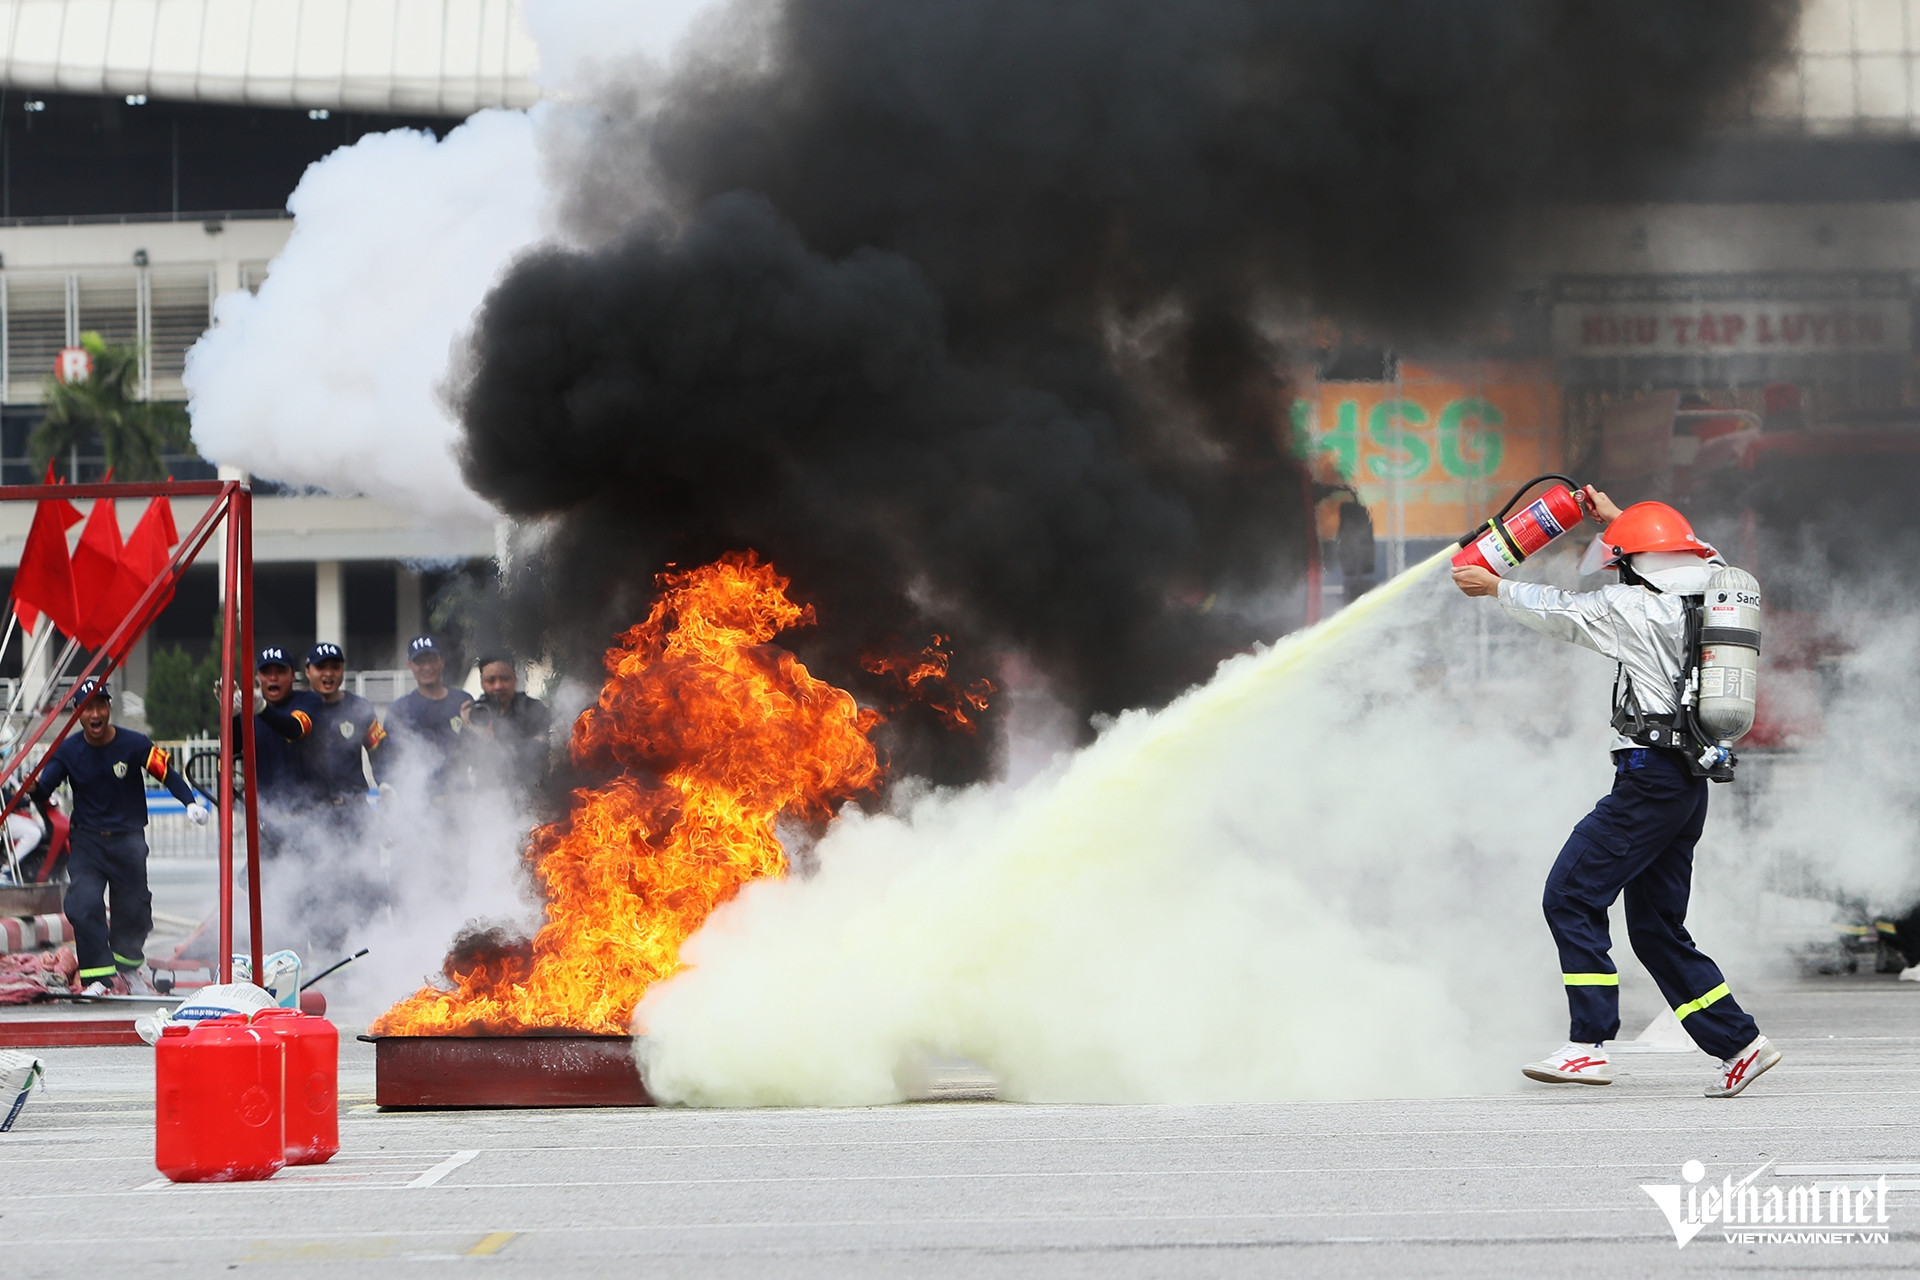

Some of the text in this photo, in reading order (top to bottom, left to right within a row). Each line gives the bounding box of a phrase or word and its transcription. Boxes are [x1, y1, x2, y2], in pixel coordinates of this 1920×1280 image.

[63, 351, 89, 384] R
[1288, 396, 1504, 482] HSG
[1736, 592, 1761, 606] SanC
[316, 644, 338, 656] 114
[412, 637, 433, 650] 114
[262, 648, 282, 660] 114
[1727, 668, 1739, 696] 공기
